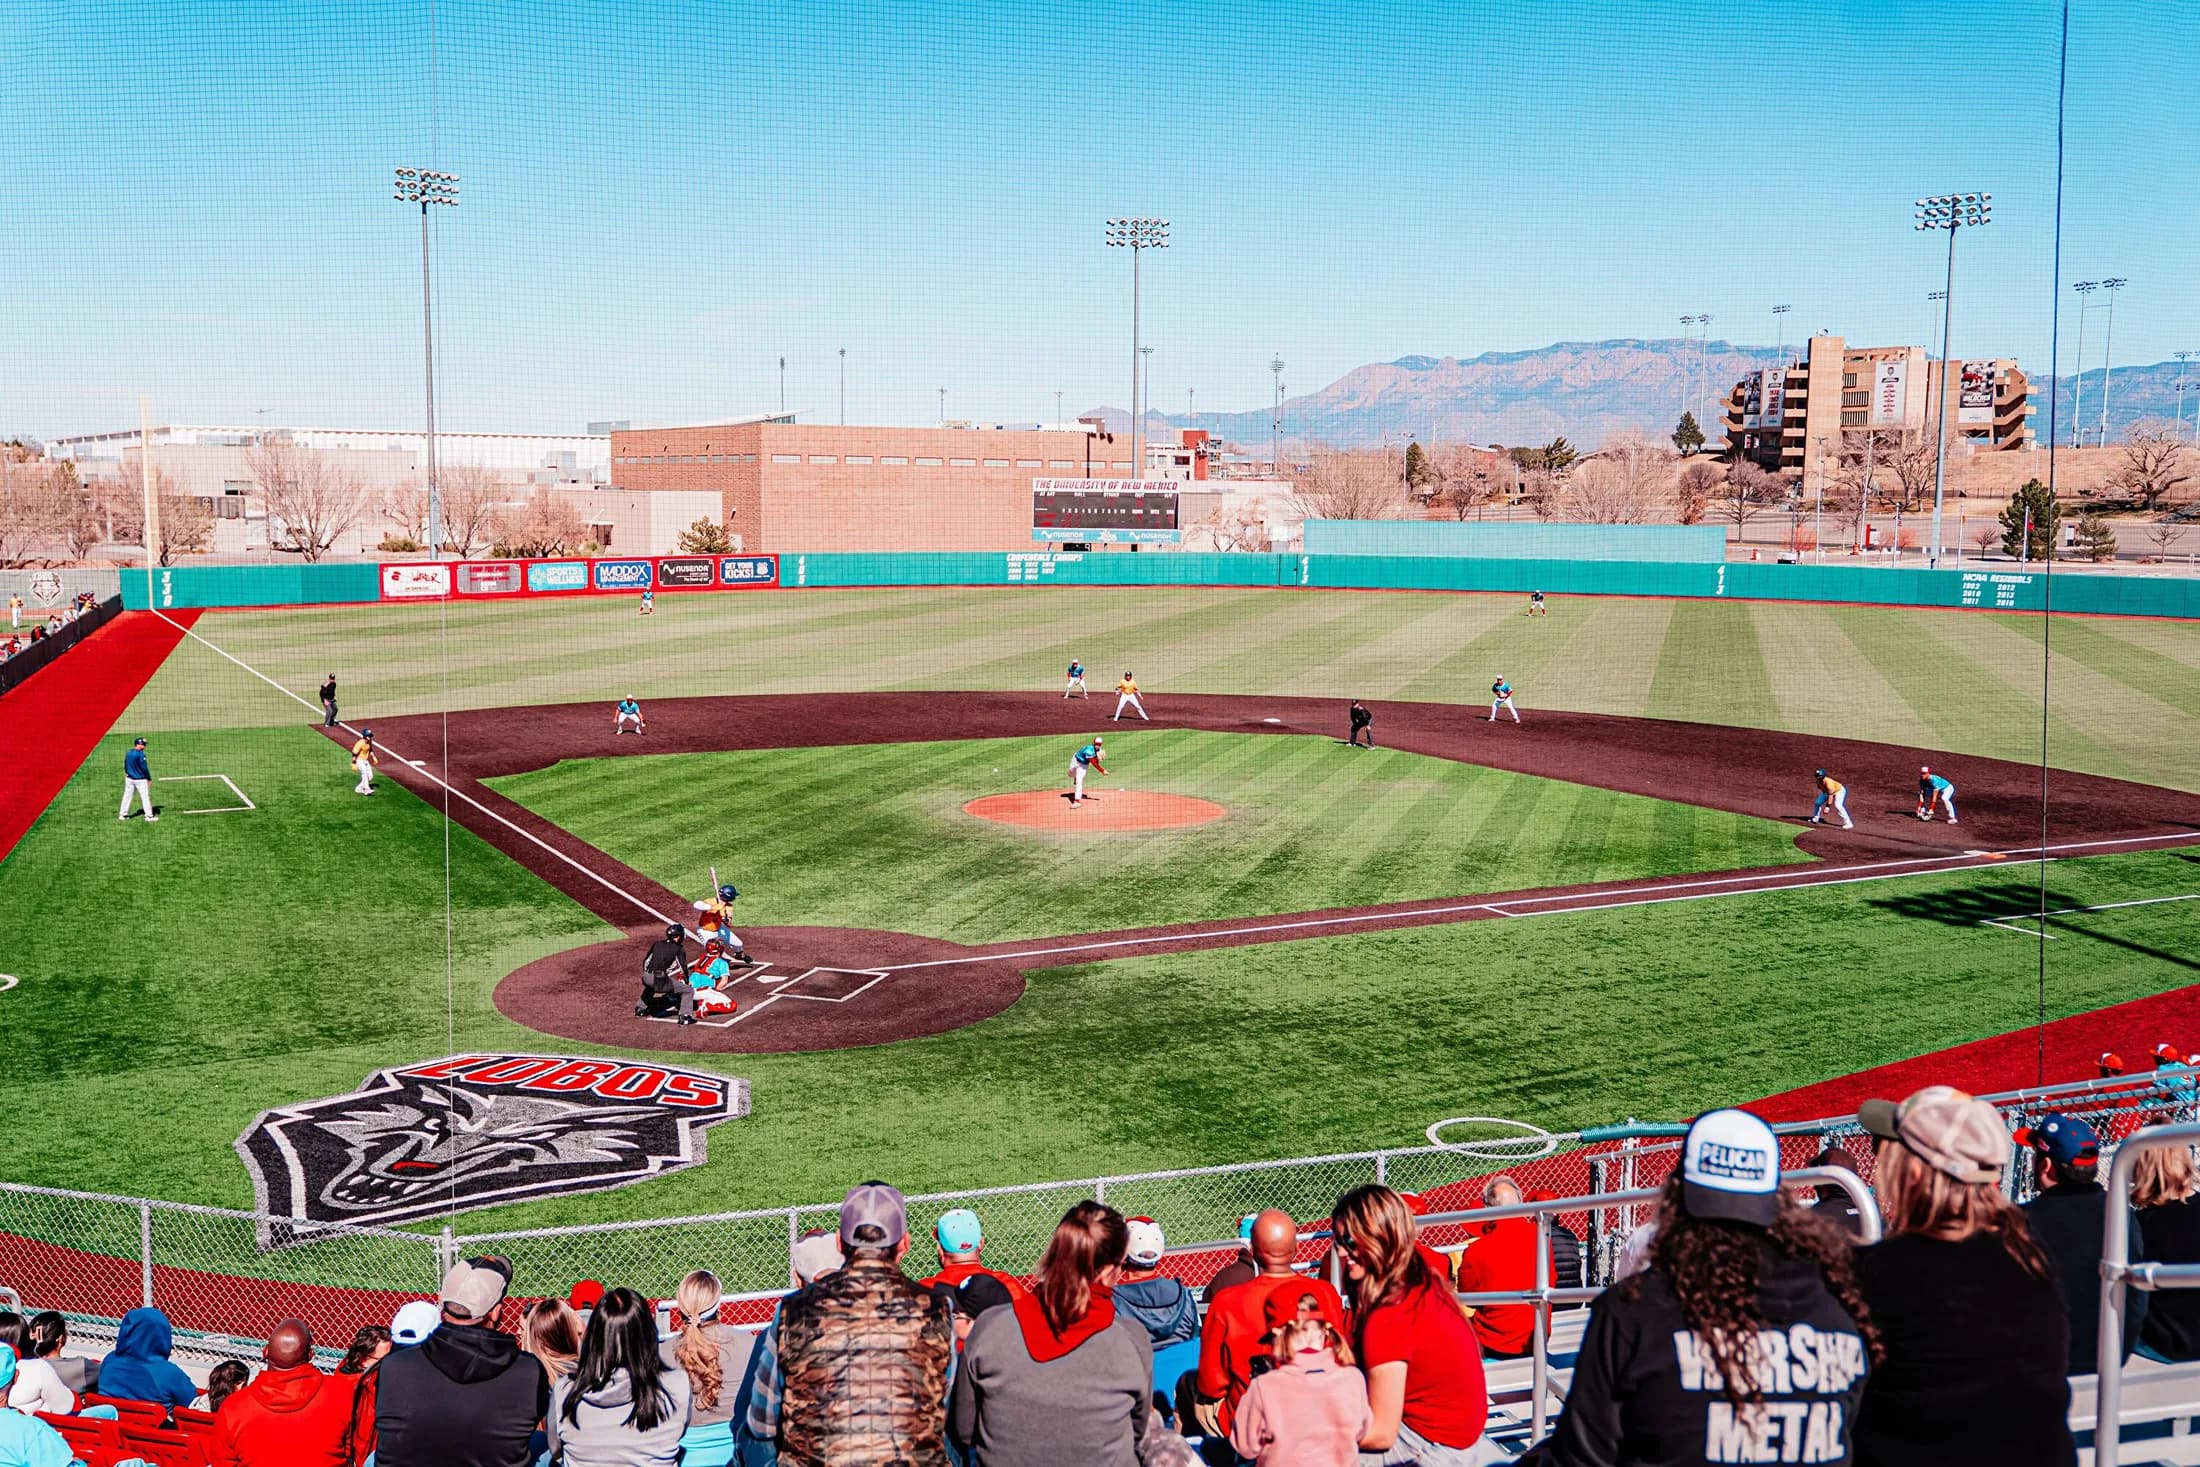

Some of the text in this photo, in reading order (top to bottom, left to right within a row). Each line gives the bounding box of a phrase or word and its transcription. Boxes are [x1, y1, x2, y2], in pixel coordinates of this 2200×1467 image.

[1035, 480, 1178, 490] THE UNIVERSITY OF NEW MEXICO
[547, 567, 577, 575] SPORTS
[547, 575, 584, 584] WELLNESS
[600, 564, 648, 578] MADDOX
[725, 569, 754, 578] KICKS!
[1715, 565, 1725, 594] 413
[1990, 575, 2032, 583] REGIONALS
[162, 571, 173, 606] 338
[397, 1055, 723, 1108] LOBOS
[1702, 1143, 1766, 1169] PELICAN
[1673, 1323, 1866, 1394] WRSHIP
[1706, 1401, 1845, 1463] METAL
